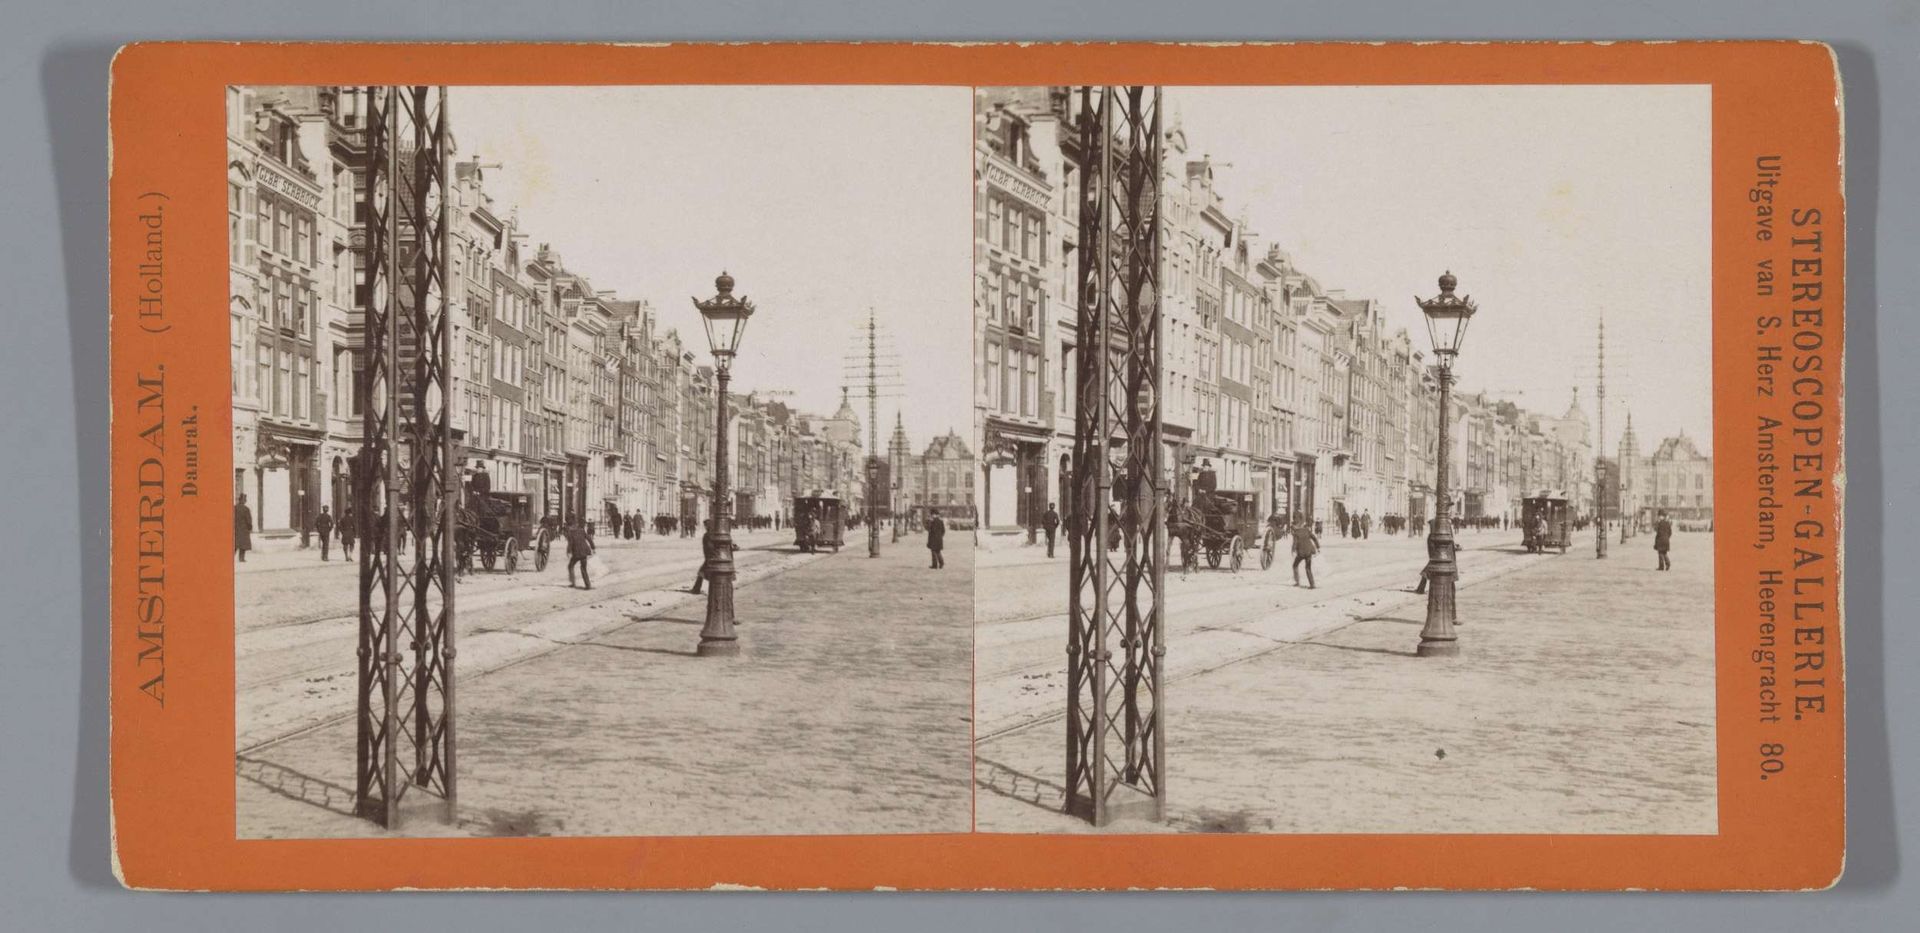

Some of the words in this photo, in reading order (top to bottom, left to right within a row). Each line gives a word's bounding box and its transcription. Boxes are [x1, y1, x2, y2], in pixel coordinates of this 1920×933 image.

[1748, 155, 1782, 241] Uitgave
[138, 192, 171, 334] (Holland.)
[1756, 257, 1774, 297] van
[1756, 346, 1783, 397] Herz
[1757, 316, 1783, 336] S.
[181, 405, 199, 497] Damrak.
[1753, 415, 1783, 550] Amsterdam,
[1791, 207, 1826, 721] STEREOSCOPEN-GALLERIE.
[137, 364, 165, 709] AMSTERDAM.
[1751, 570, 1784, 723] Heerengracht
[1759, 743, 1785, 781] 80.
